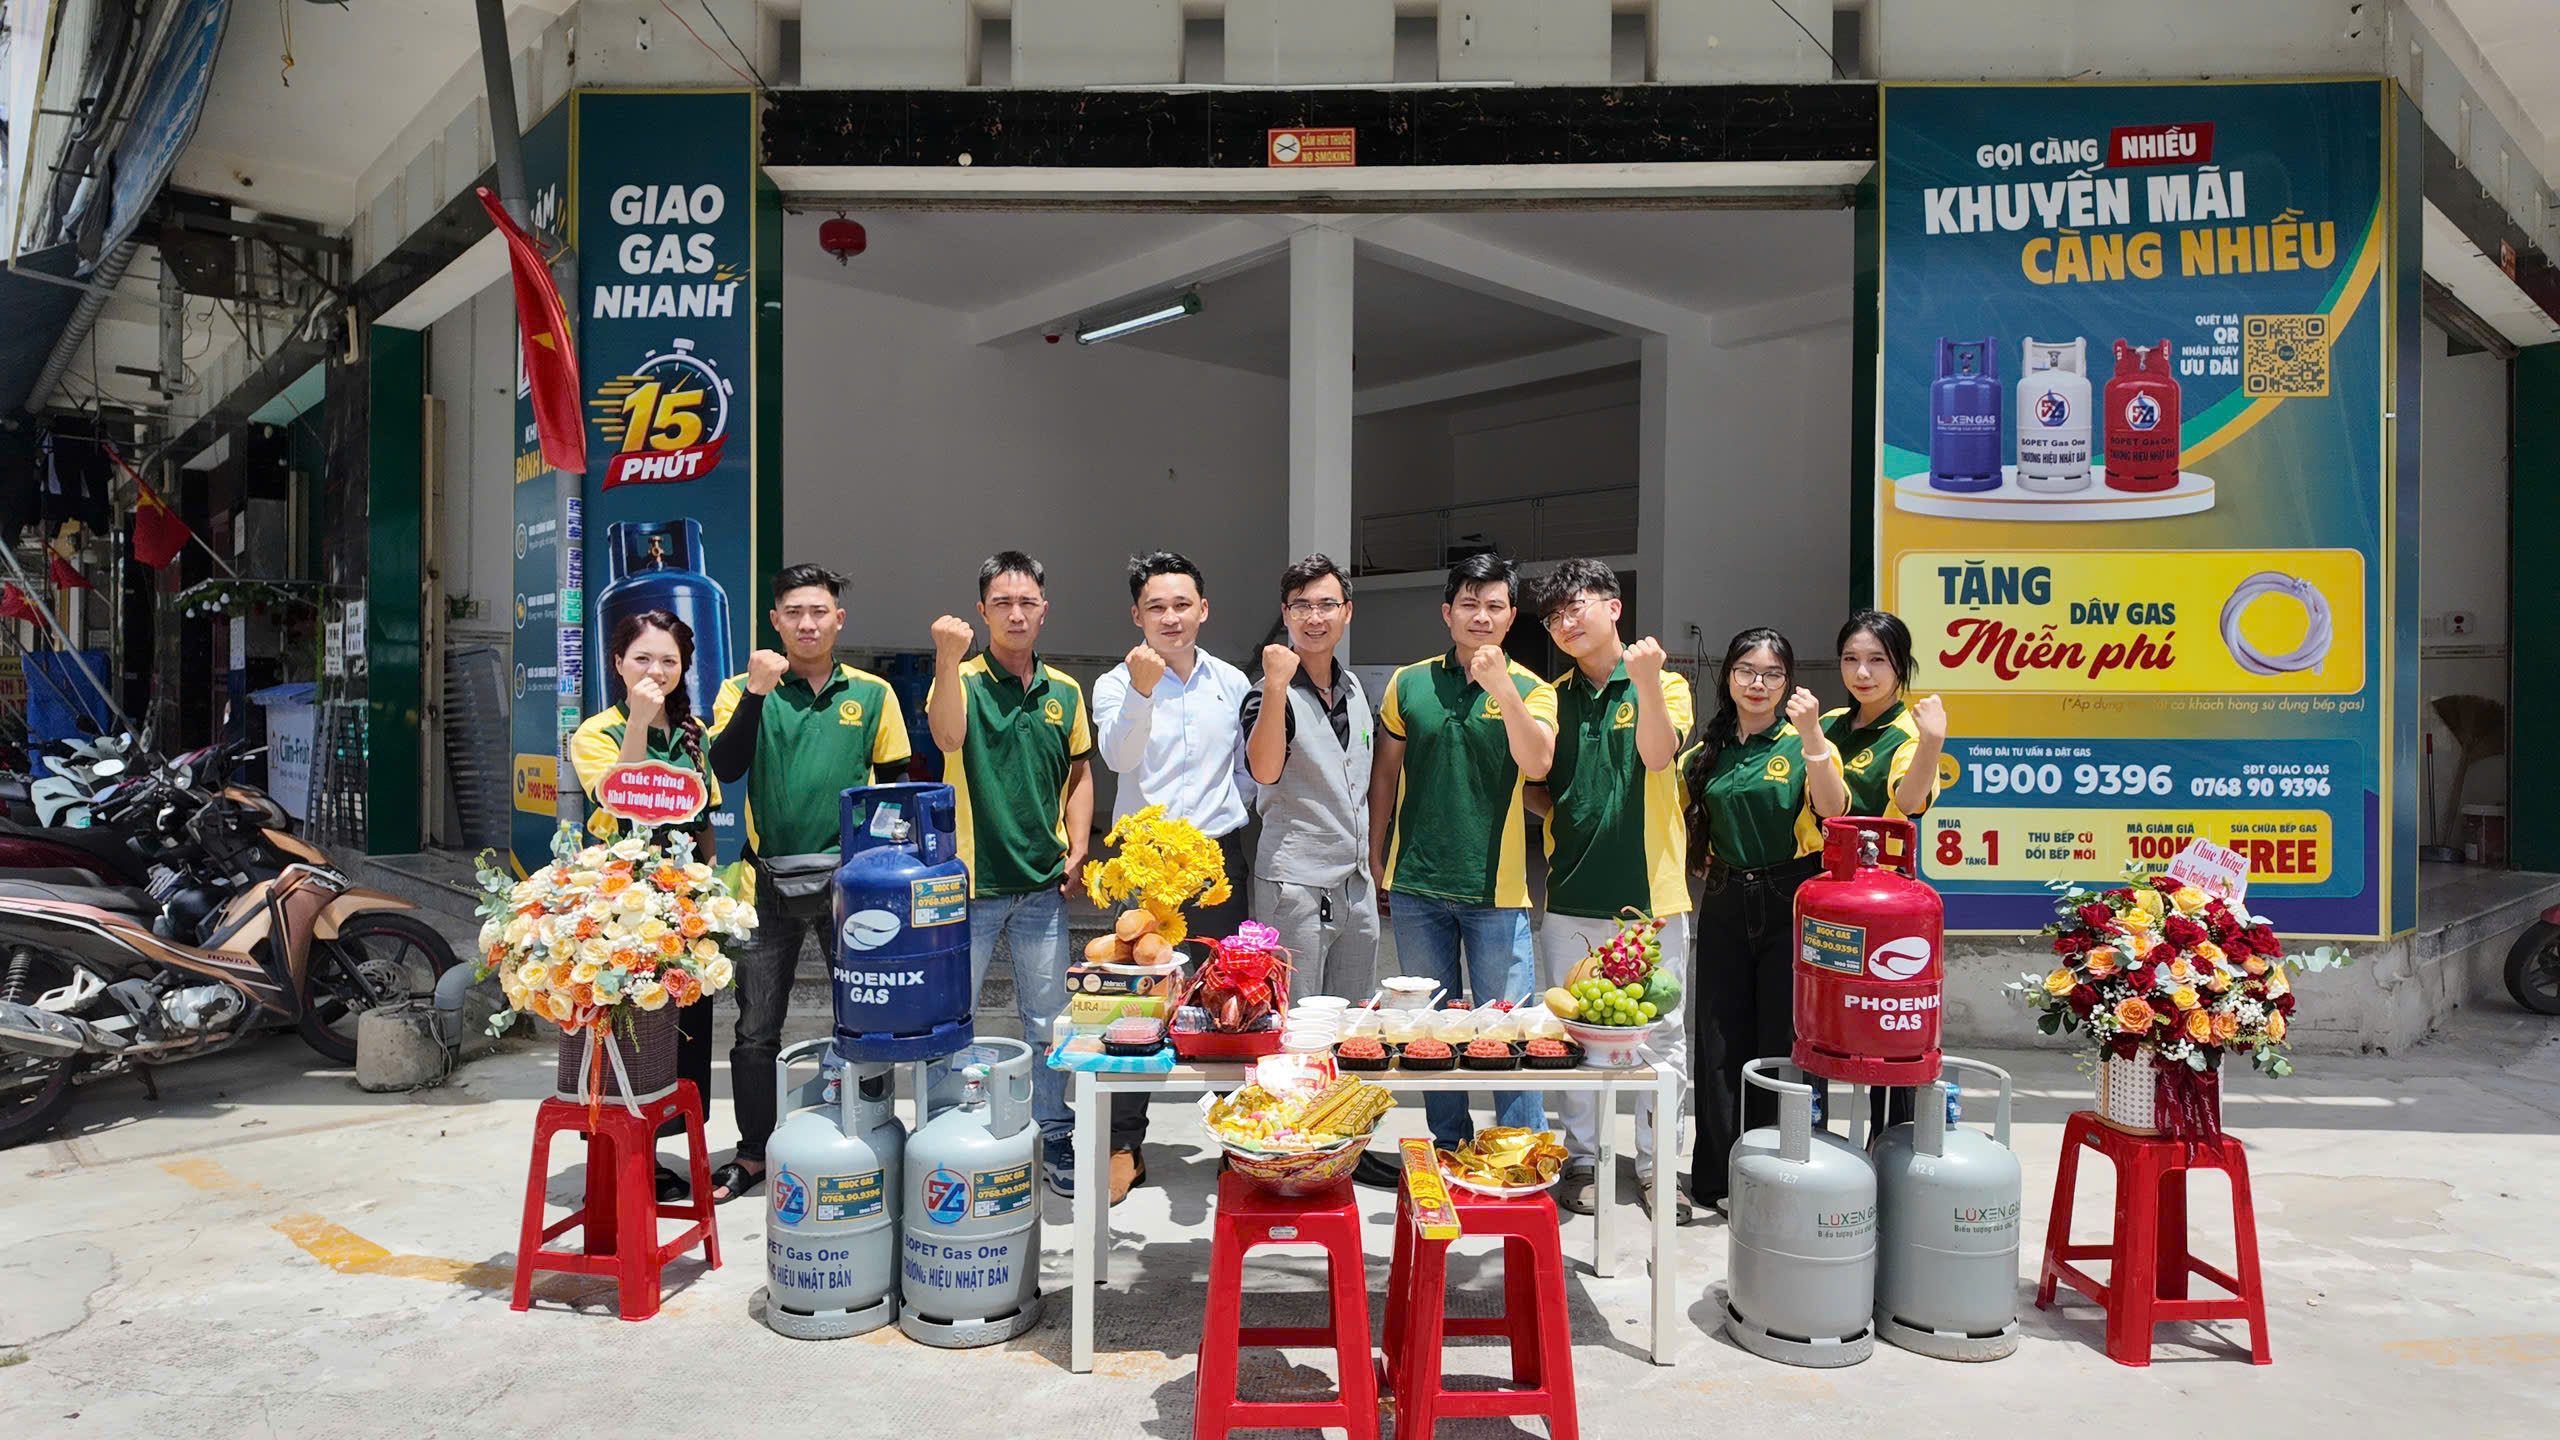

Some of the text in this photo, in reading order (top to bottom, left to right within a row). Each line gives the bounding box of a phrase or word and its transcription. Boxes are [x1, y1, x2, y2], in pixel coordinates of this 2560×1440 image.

[1302, 151, 1350, 162] NO SMOKING
[1976, 126, 2197, 171] GỌI CÀNG NHIỀU
[610, 184, 725, 226] GIAO
[1923, 163, 2246, 234] KHUYẾN MÃI
[618, 233, 716, 276] GAS
[2021, 207, 2336, 285] CÀNG NHIỀU
[593, 284, 737, 319] NHANH
[2214, 327, 2239, 344] QR
[2182, 345, 2239, 357] NHẬN NGAY
[2180, 357, 2239, 376] ƯU ĐÃI
[622, 382, 705, 453] 15
[1975, 415, 1996, 424] GAS
[2021, 438, 2048, 447] SOPET
[2072, 438, 2086, 446] One
[620, 451, 703, 482] PHÚT
[1938, 559, 2051, 610] TẶNG
[2070, 598, 2176, 625] DÂY GAS
[1939, 617, 2176, 681] Miễn phí
[2189, 697, 2223, 710] khách
[2228, 698, 2257, 713] hàng
[2279, 697, 2309, 713] dụng
[2312, 695, 2336, 713] bếp
[2339, 698, 2365, 713] gas)
[2073, 748, 2091, 757] GAS
[621, 771, 650, 786] Chúc
[2243, 764, 2330, 775] SĐT GIAO GAS
[1968, 763, 2173, 795] 1900 9396
[2191, 777, 2331, 797] 0768 90 9396
[1938, 819, 1961, 829] MUA
[2280, 821, 2297, 833] BẾP
[2299, 824, 2318, 833] GAS
[2028, 832, 2050, 843] THU
[2054, 829, 2075, 843] BẾP
[1936, 830, 1963, 866] 8
[1982, 830, 1999, 866] 1
[2049, 846, 2070, 860] BẾP
[2193, 839, 2217, 861] Chúc
[207, 953, 252, 967] HONDA
[834, 966, 925, 986] PHOENIX
[850, 987, 889, 1005] GAS
[1844, 993, 1941, 1011] PHOENIX
[1073, 1001, 1098, 1012] HURA
[1880, 1014, 1922, 1031] GAS
[821, 1188, 880, 1203] 0768.90.9396
[786, 1246, 813, 1261] Gas
[818, 1249, 849, 1262] One
[905, 1233, 1008, 1260] SOPET Gas One
[777, 1264, 795, 1290] HIỆU
[798, 1266, 825, 1293] NHẬT
[829, 1263, 852, 1288] BẢN
[929, 1264, 952, 1291] HIỆU
[955, 1265, 984, 1293] NHẬT
[988, 1260, 1008, 1286] BẢN
